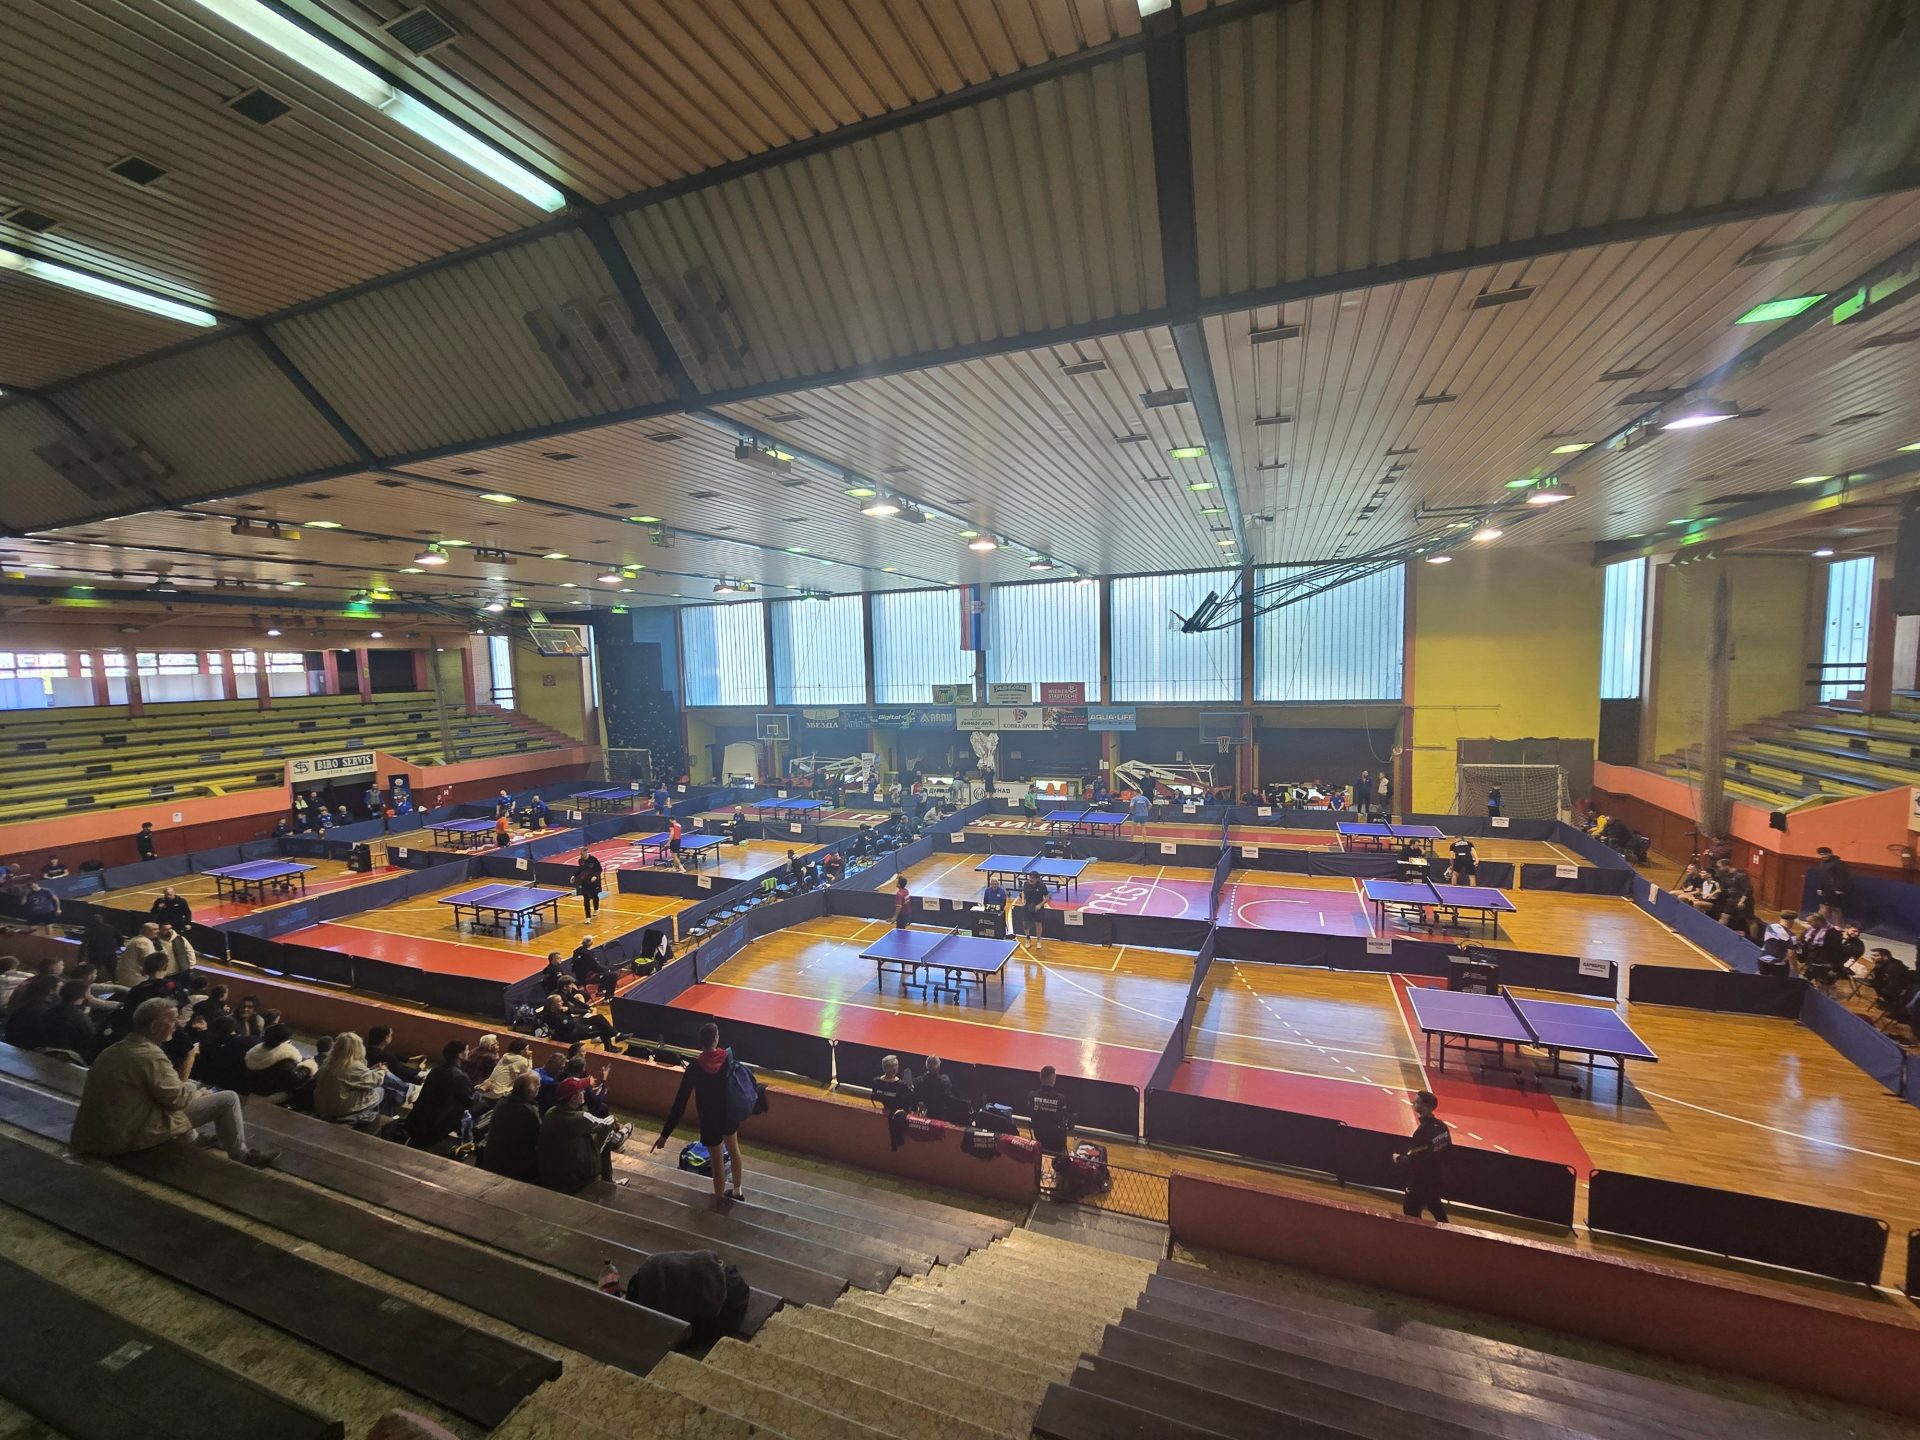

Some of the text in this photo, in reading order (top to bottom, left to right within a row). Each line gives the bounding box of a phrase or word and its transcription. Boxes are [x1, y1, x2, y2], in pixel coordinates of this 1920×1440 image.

[806, 721, 839, 729] ЗВЕЗДА
[316, 758, 339, 770] BIRO
[342, 754, 371, 767] SERVIS
